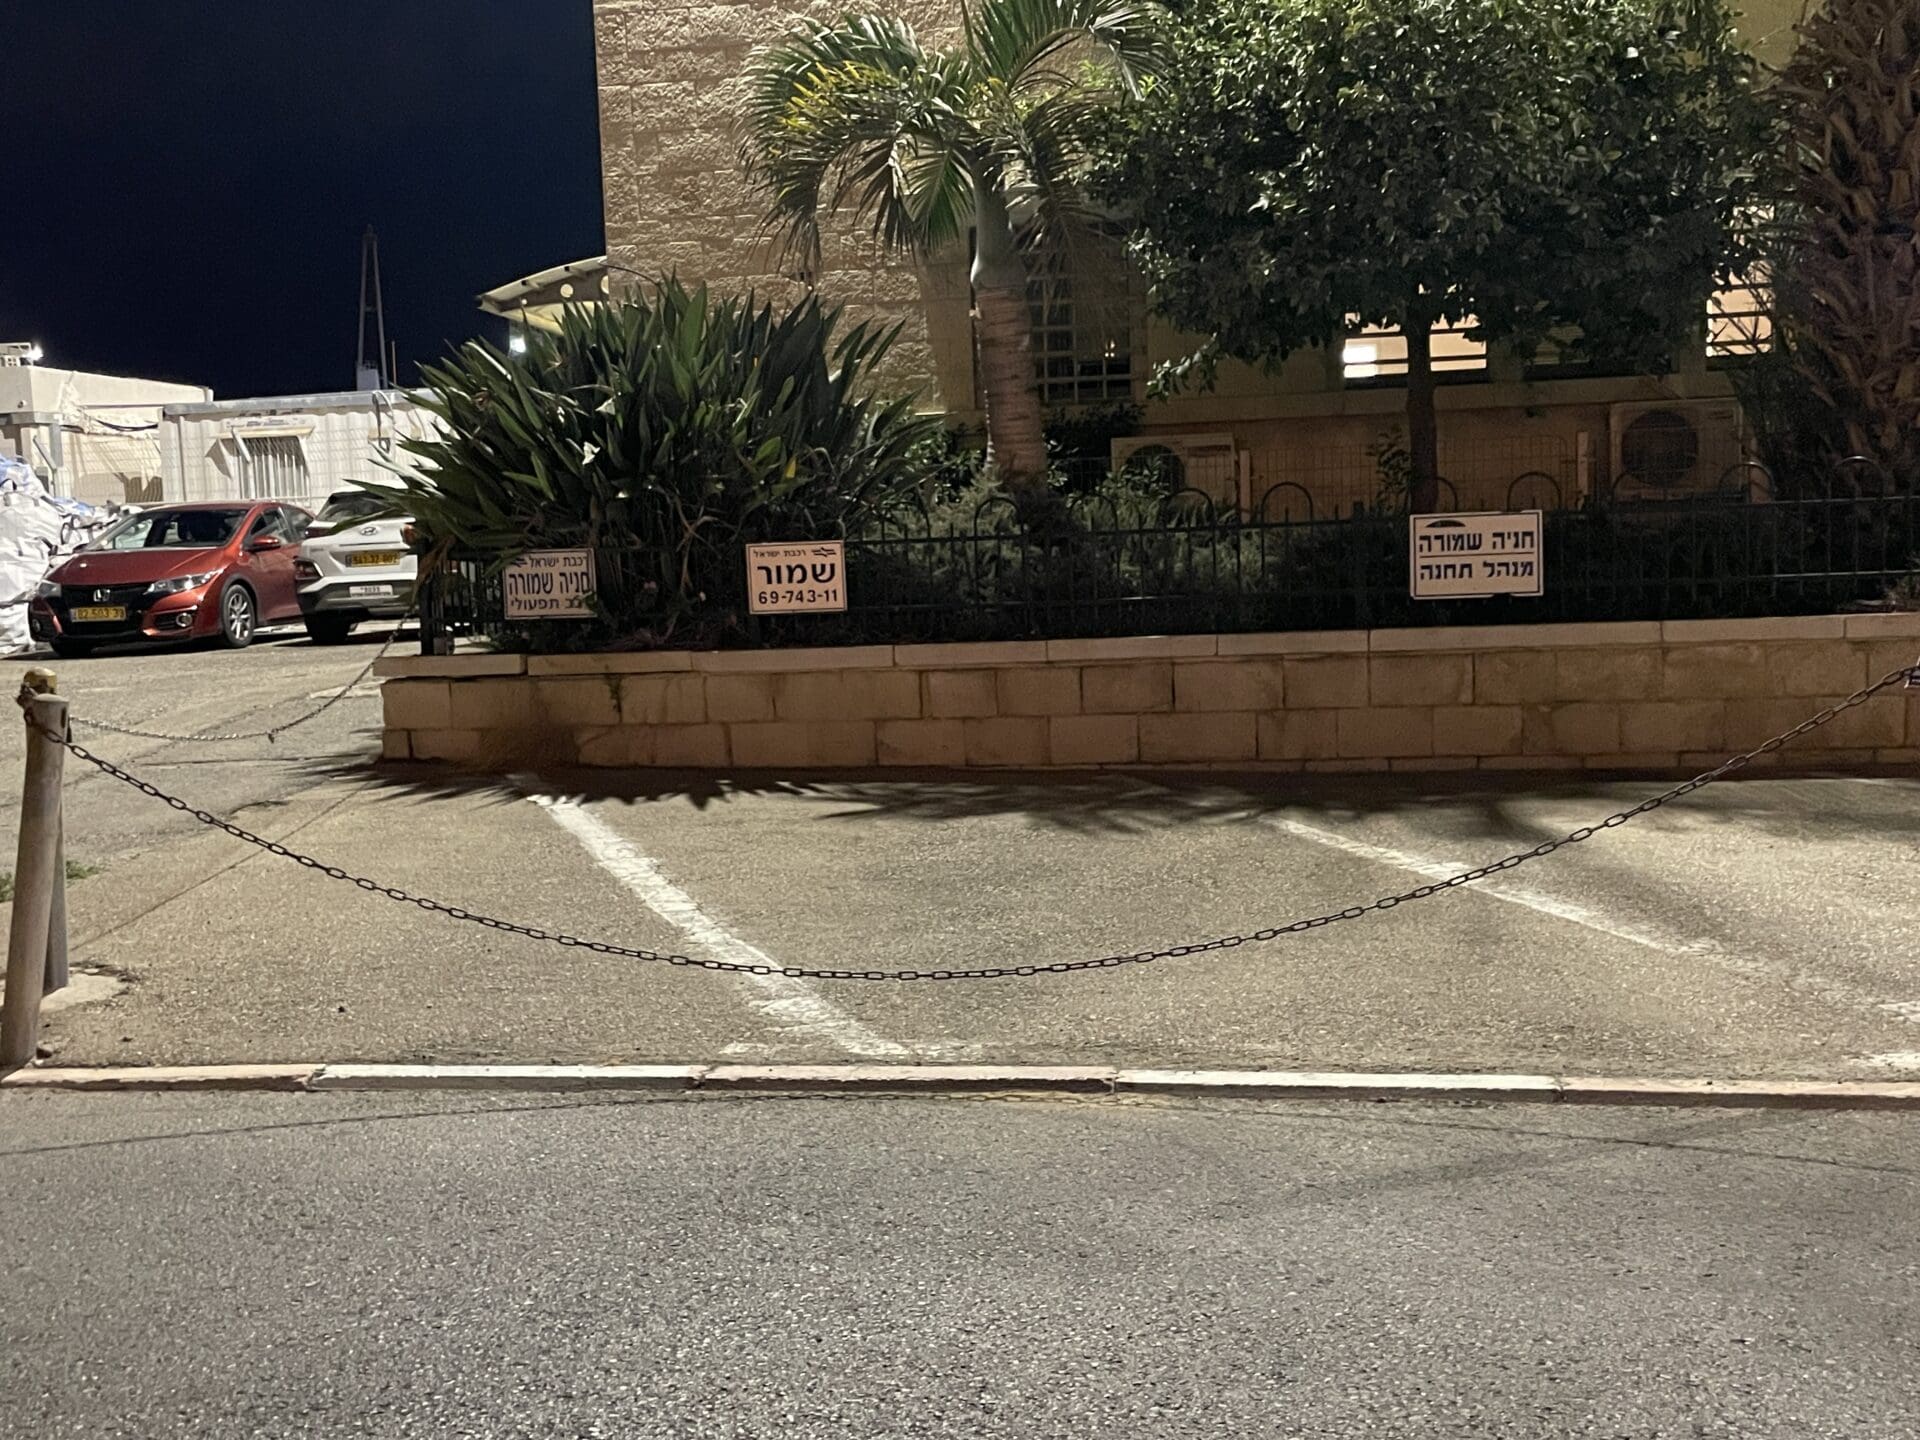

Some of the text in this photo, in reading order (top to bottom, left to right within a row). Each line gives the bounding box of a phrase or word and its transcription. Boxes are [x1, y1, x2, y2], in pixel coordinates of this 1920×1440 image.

[1419, 531, 1534, 552] חניה שמורה
[528, 555, 560, 568] ישראל
[753, 549, 806, 558] רכבת ישראל
[757, 563, 835, 585] שמור
[1420, 560, 1533, 580] מנהל תחנה
[508, 572, 553, 595] שמורה
[511, 598, 560, 610] תפעולי
[758, 589, 838, 604] 69-743-11
